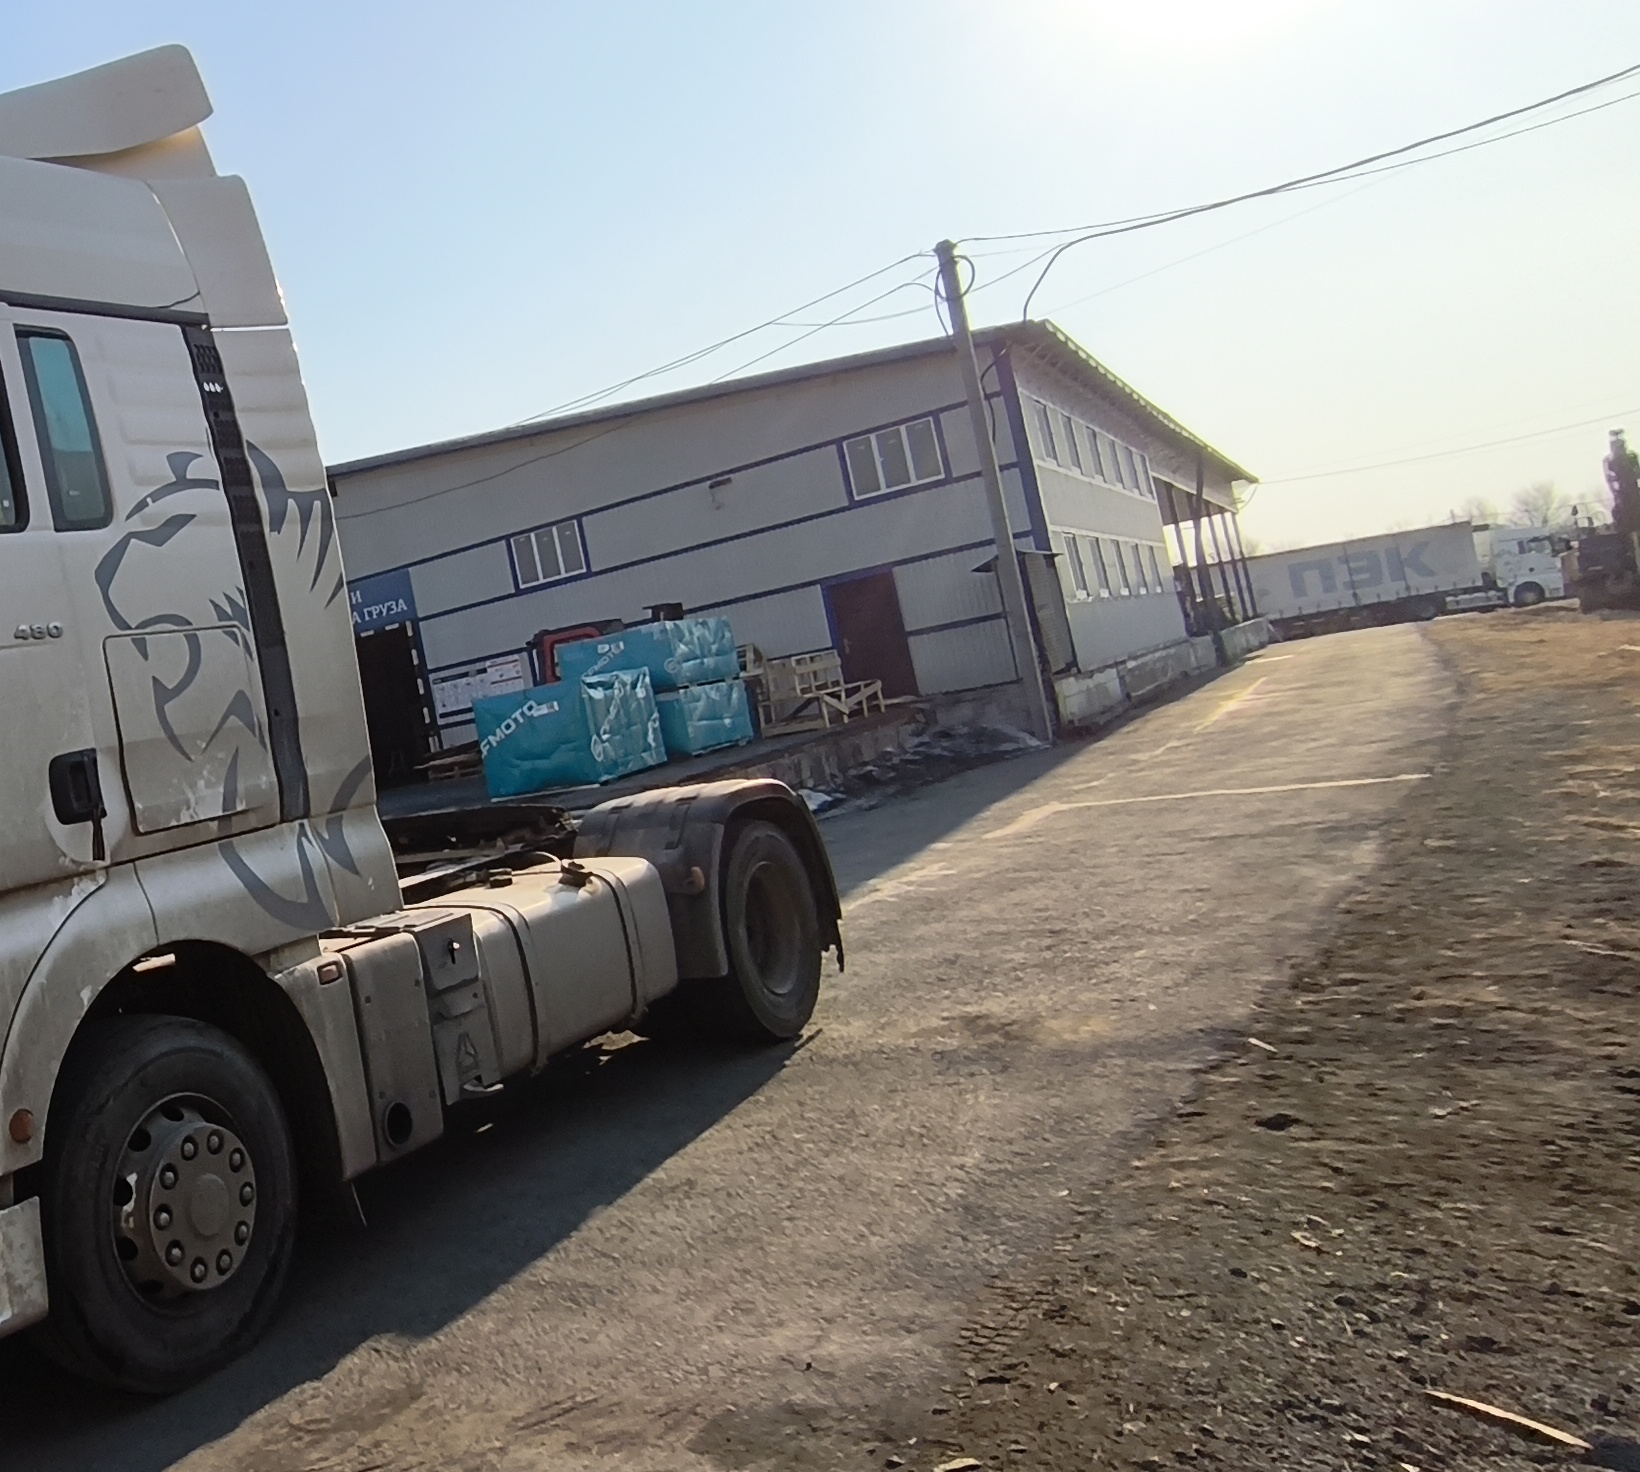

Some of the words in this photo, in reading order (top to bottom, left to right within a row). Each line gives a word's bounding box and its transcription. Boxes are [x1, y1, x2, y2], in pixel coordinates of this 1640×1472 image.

[1288, 541, 1438, 598] ПЭК
[363, 598, 408, 621] ГРУЗА
[13, 621, 64, 641] 480
